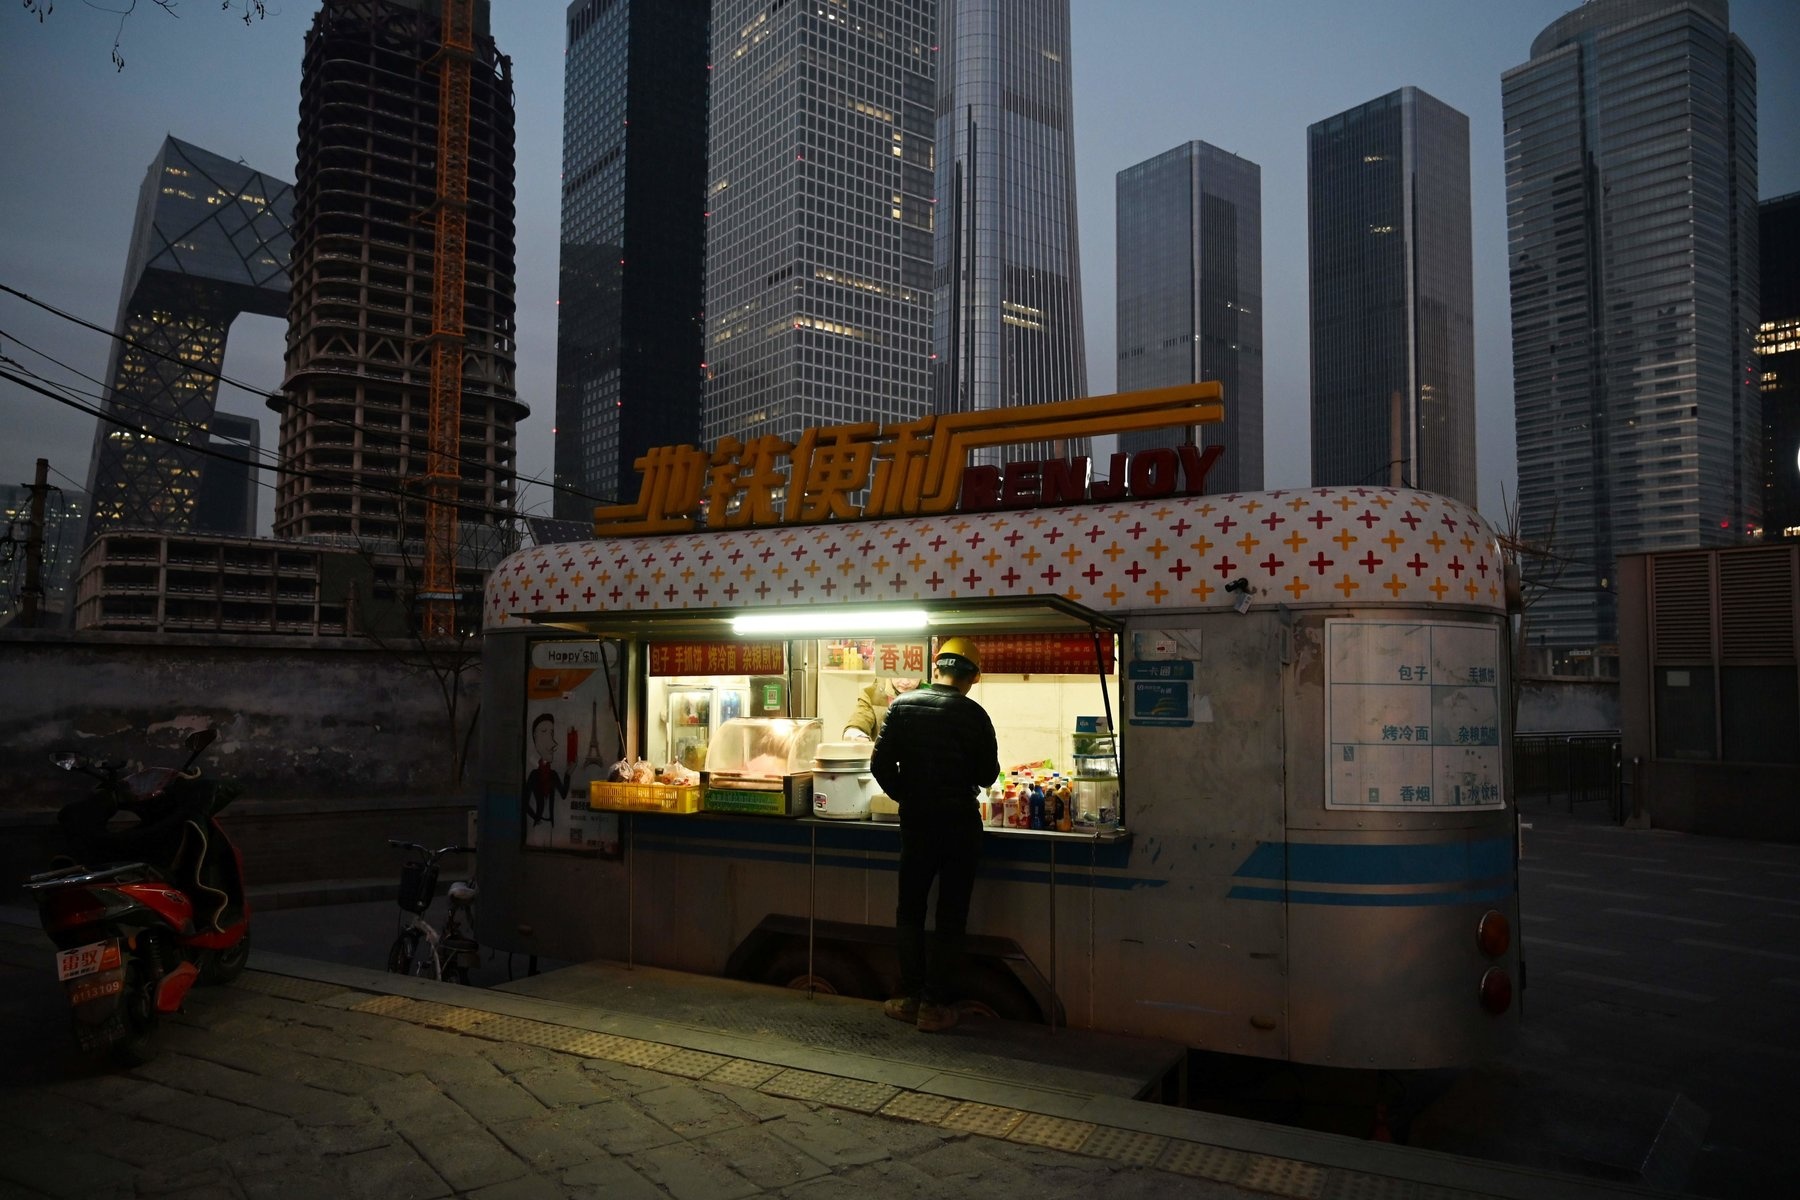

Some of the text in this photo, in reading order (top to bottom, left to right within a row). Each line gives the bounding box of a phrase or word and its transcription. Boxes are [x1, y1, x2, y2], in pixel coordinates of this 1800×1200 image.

[961, 444, 1226, 512] RENJOY
[548, 650, 580, 663] Happy
[652, 643, 782, 673] 包子 手抓饼 烤冷面 杂粮煎饼
[880, 643, 924, 673] 香烟
[1398, 665, 1429, 681] 包子
[1382, 724, 1429, 741] 烤冷面
[1400, 785, 1430, 802] 香烟
